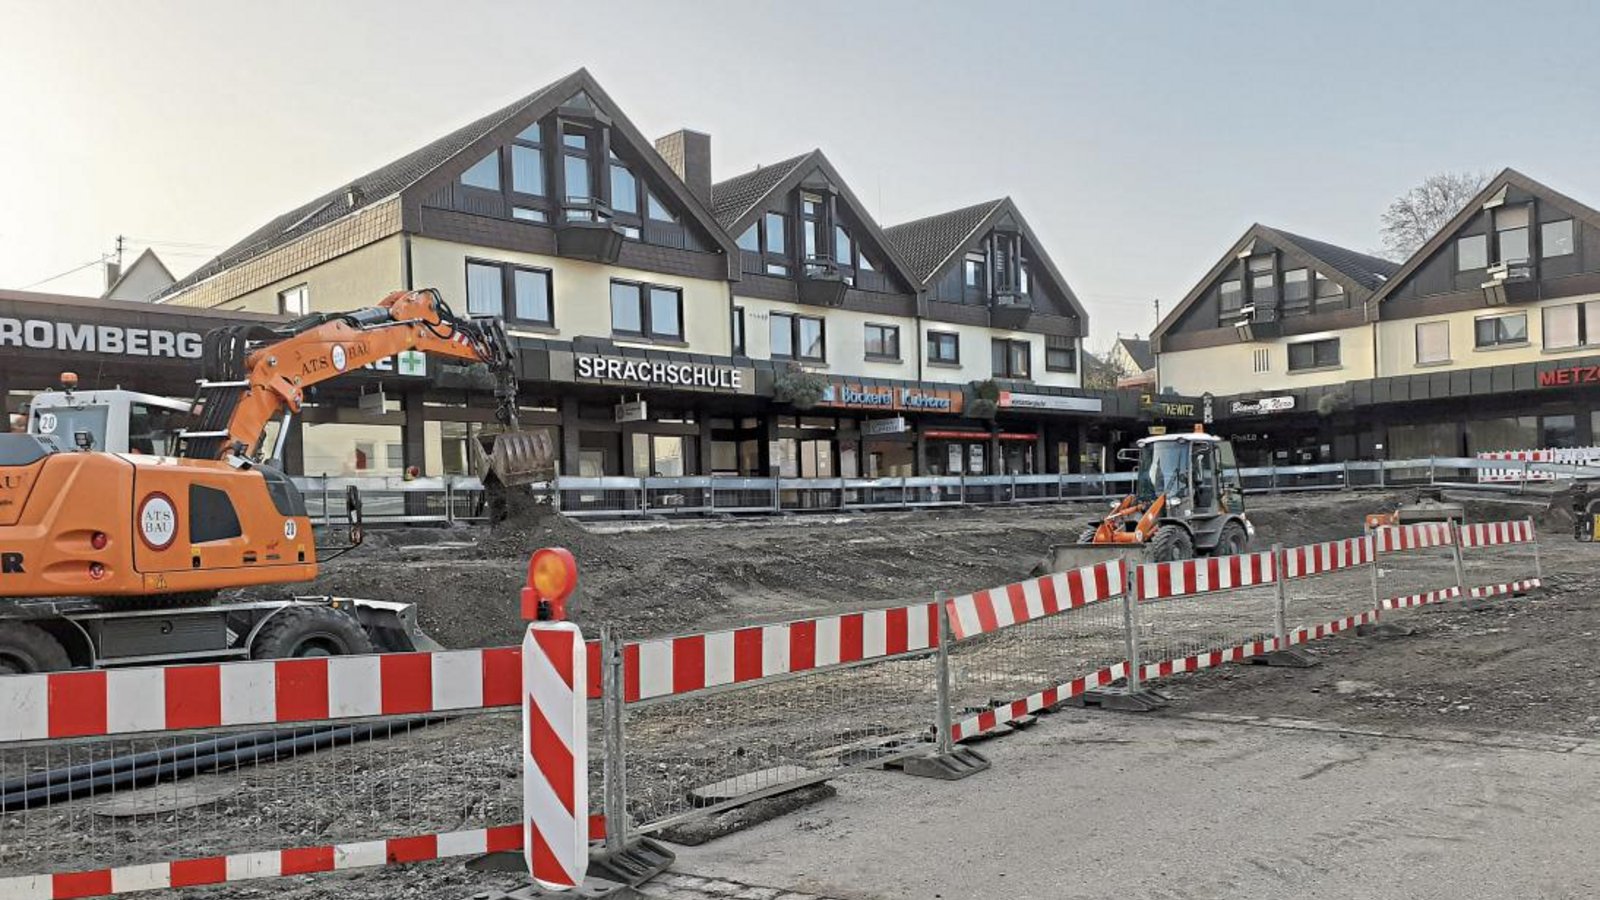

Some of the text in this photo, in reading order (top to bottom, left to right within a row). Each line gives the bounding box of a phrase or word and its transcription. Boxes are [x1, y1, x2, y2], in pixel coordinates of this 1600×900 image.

[0, 318, 203, 358] ROMBERG
[301, 356, 329, 376] ATS
[577, 356, 742, 388] SPRACHSCHULE
[41, 415, 56, 430] 20
[145, 511, 171, 520] ATS
[145, 522, 171, 533] BAU
[286, 522, 295, 536] 20
